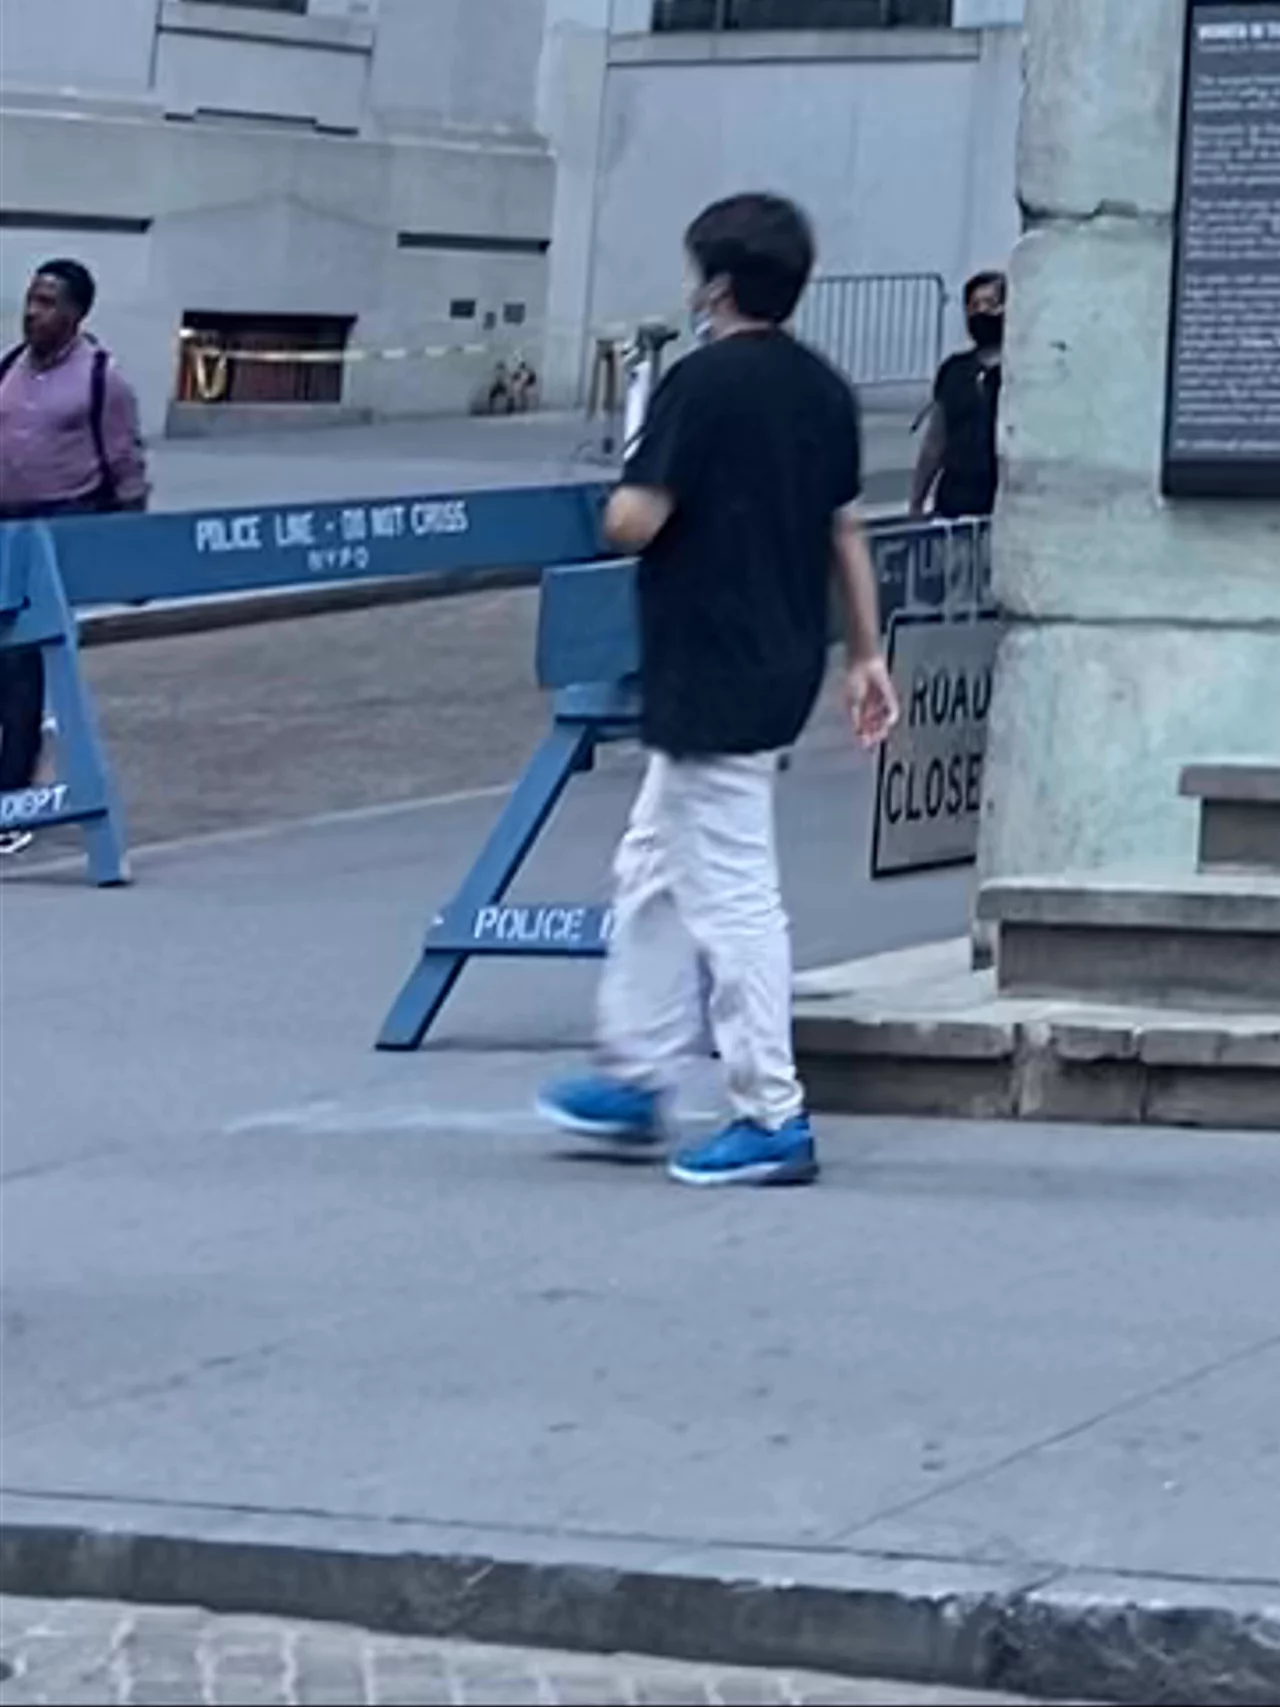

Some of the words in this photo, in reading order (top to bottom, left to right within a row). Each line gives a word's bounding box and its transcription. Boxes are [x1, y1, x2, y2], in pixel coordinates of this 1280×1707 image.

[196, 515, 263, 551] POLICE
[274, 511, 316, 545] LINE
[341, 508, 367, 539] DO
[371, 505, 405, 538] NOT
[410, 500, 469, 536] CROSS
[885, 754, 982, 825] CLOSE
[474, 906, 584, 940] POLICE
